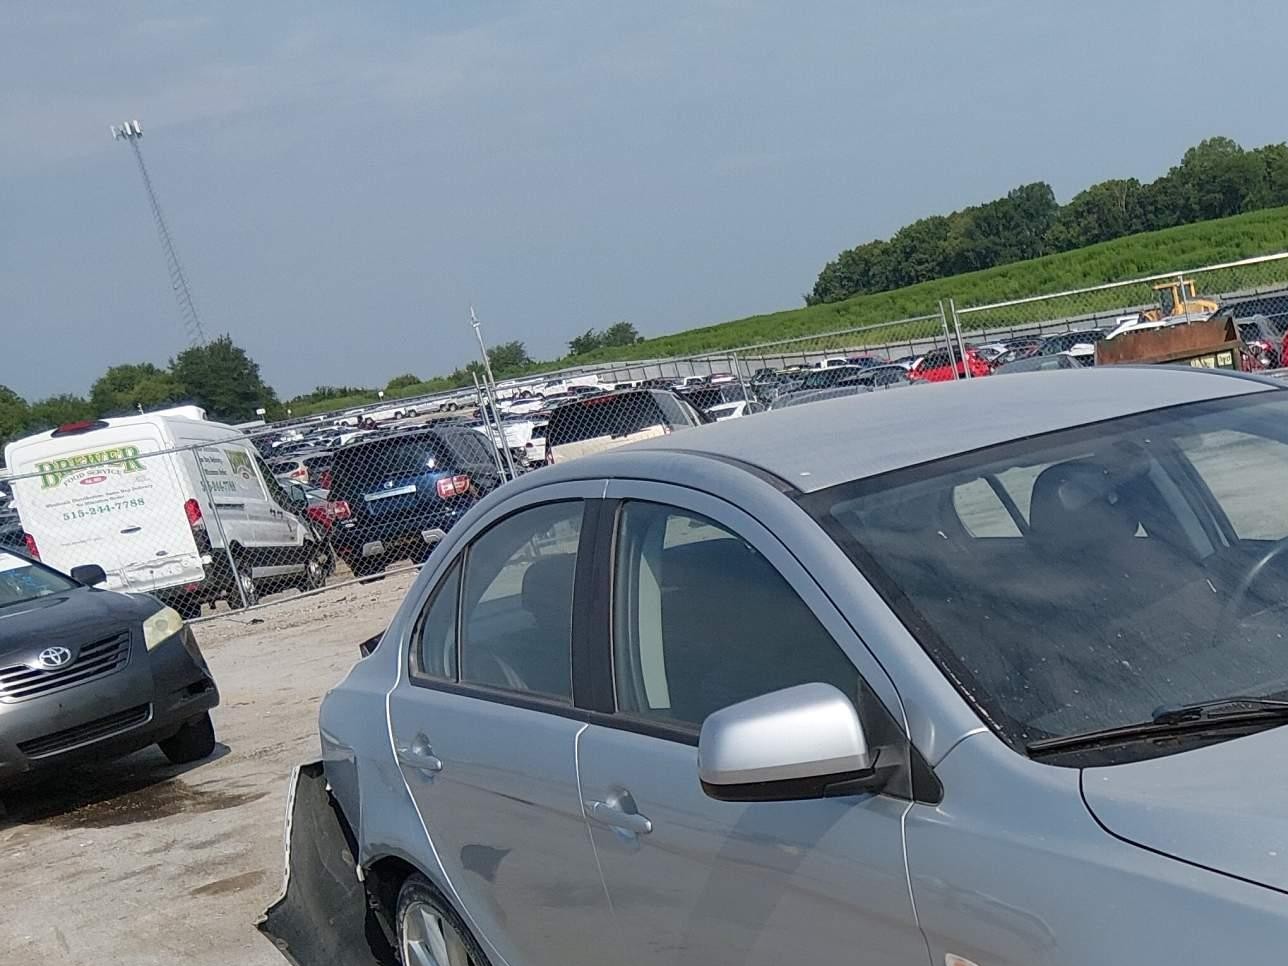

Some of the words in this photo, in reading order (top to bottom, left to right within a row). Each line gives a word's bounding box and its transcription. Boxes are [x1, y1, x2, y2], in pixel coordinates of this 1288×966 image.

[35, 445, 147, 489] BREWER
[63, 472, 85, 487] FOOD
[86, 468, 122, 476] SERVICE
[63, 497, 145, 521] 515-244-7788
